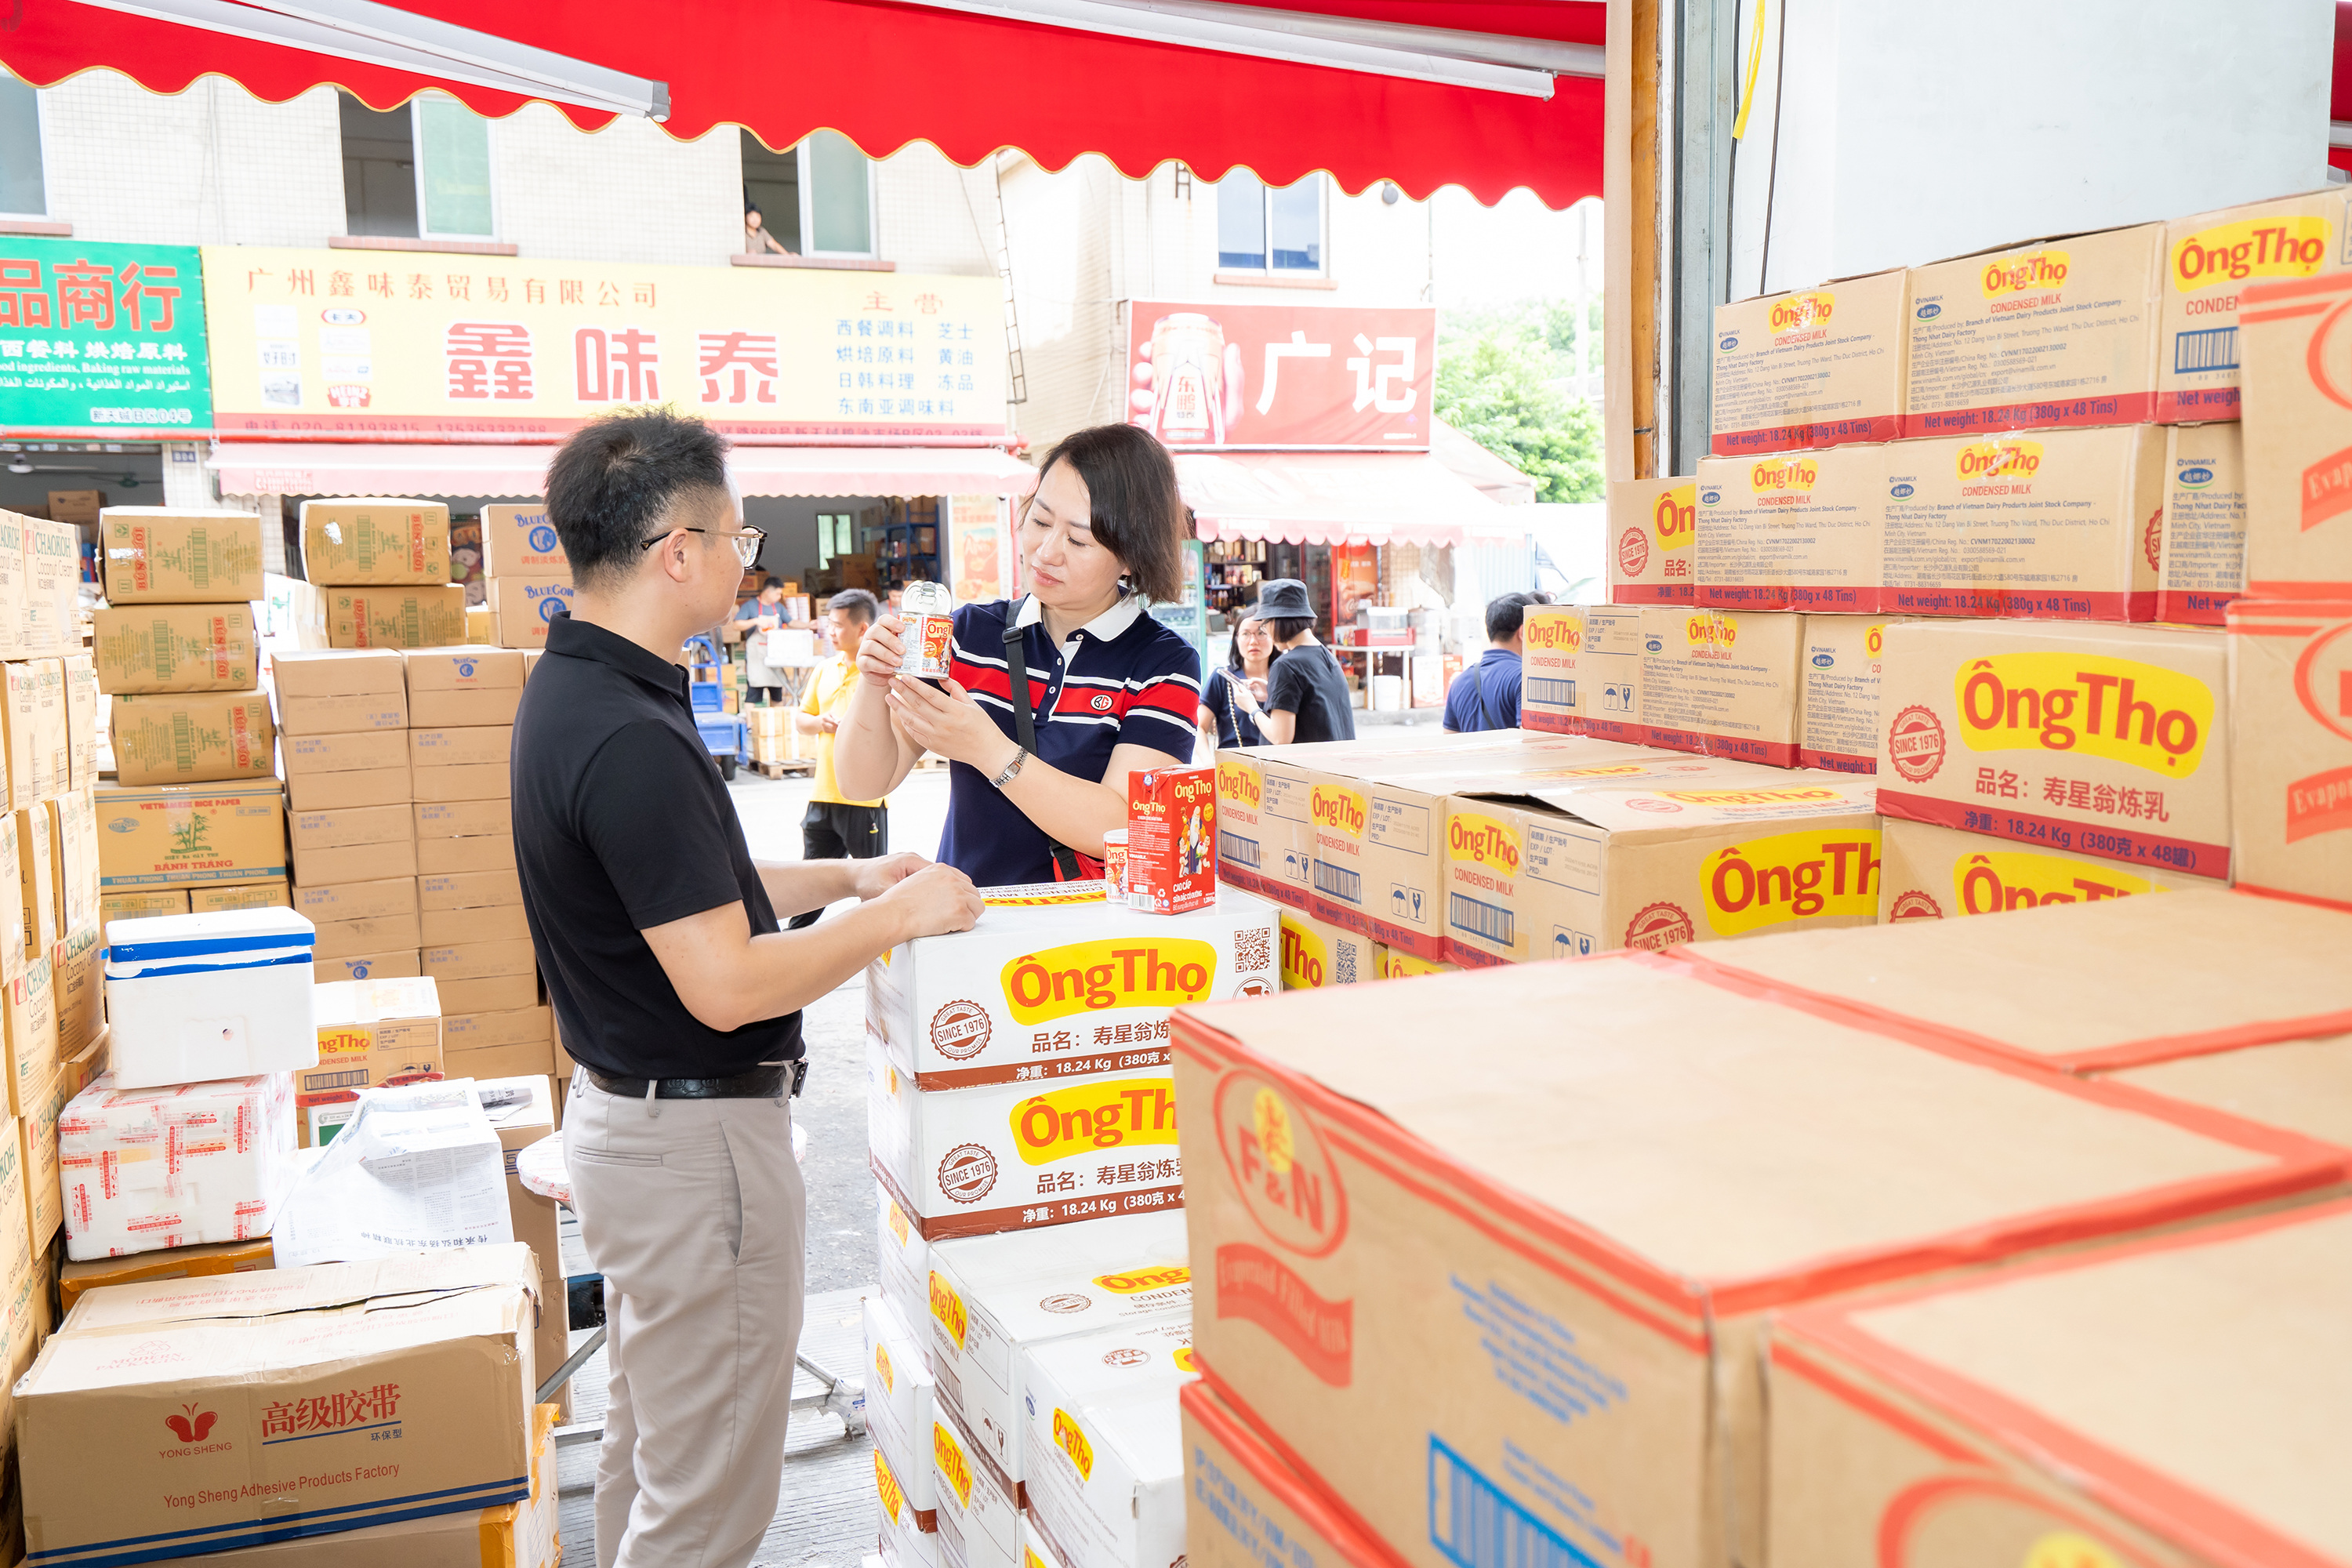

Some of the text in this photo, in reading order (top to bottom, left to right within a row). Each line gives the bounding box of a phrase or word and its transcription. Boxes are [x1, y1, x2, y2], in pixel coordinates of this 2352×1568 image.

[2179, 227, 2325, 280] ÔngThọ
[248, 267, 657, 307] 广州鑫味泰贸易有限公司
[1986, 257, 2067, 291] ÔngThọ
[0, 260, 180, 332] 品商行
[862, 291, 943, 314] 主营
[1991, 293, 2062, 314] CONDENSED MILK
[837, 319, 974, 339] 西餐调料 芝士
[82, 362, 119, 376] Baking
[122, 365, 140, 373] raw
[143, 364, 191, 375] materials
[445, 321, 779, 404] 鑫味泰
[938, 347, 974, 367] 黄油
[1255, 330, 1417, 416] 广记
[838, 372, 974, 392] 日韩料理 冻品
[1178, 376, 1196, 411] 东鹏
[837, 397, 954, 417] 东南亚调味料
[1754, 458, 1816, 488] ÔngThọ
[1960, 446, 2039, 477] ÔngThọ
[1962, 485, 2031, 497] CONDENSED MILK
[35, 532, 71, 557] CHAOKOH
[36, 557, 73, 577] Coconut Cream
[1898, 594, 2091, 615] Net weight: 18.24 Kg (380g x 48 Tins)
[1528, 616, 1581, 653] ÔngThọ
[1963, 660, 2198, 768] ÔngThọ
[1895, 732, 1940, 754] SINCE 1976
[1219, 764, 1260, 805] ÔngThọ
[1976, 768, 2170, 822] 品名： 寿星翁炼乳
[140, 800, 193, 811] VIETNAMESE
[1312, 788, 1365, 834] ÔngThọ
[1450, 816, 1519, 868] ÔngThọ
[1965, 811, 1999, 831] 净重：
[2007, 818, 2046, 840] 18.24
[2051, 826, 2071, 847] Kg
[2136, 846, 2146, 857] x
[154, 859, 234, 872] BÁNH TRÁNG
[1454, 867, 1515, 897] CONDENSED MILK
[1711, 842, 1880, 916] ÔngTh
[66, 925, 97, 960] CHAOKOH
[66, 948, 100, 981] Coconut Cream
[1011, 949, 1207, 1010] ÔngThọ
[937, 1018, 985, 1044] SINCE 1976
[1032, 1020, 1171, 1053] 品名： 寿星翁炼
[1016, 1066, 1047, 1080] 净重：
[1056, 1059, 1091, 1073] 18.24
[1095, 1058, 1112, 1072] Kg
[1119, 1053, 1160, 1069] (380克
[1020, 1089, 1176, 1148] ÔngTh
[945, 1160, 991, 1186] SINCE 1976
[1239, 1123, 1325, 1234] F&N
[261, 1384, 401, 1438] 高级胶带
[158, 1442, 233, 1459] YONG SHENG
[370, 1428, 403, 1443] 环保型
[935, 1421, 971, 1511] ÔngThọ
[164, 1461, 401, 1510] Yong Sheng Adhesive Products Factory
